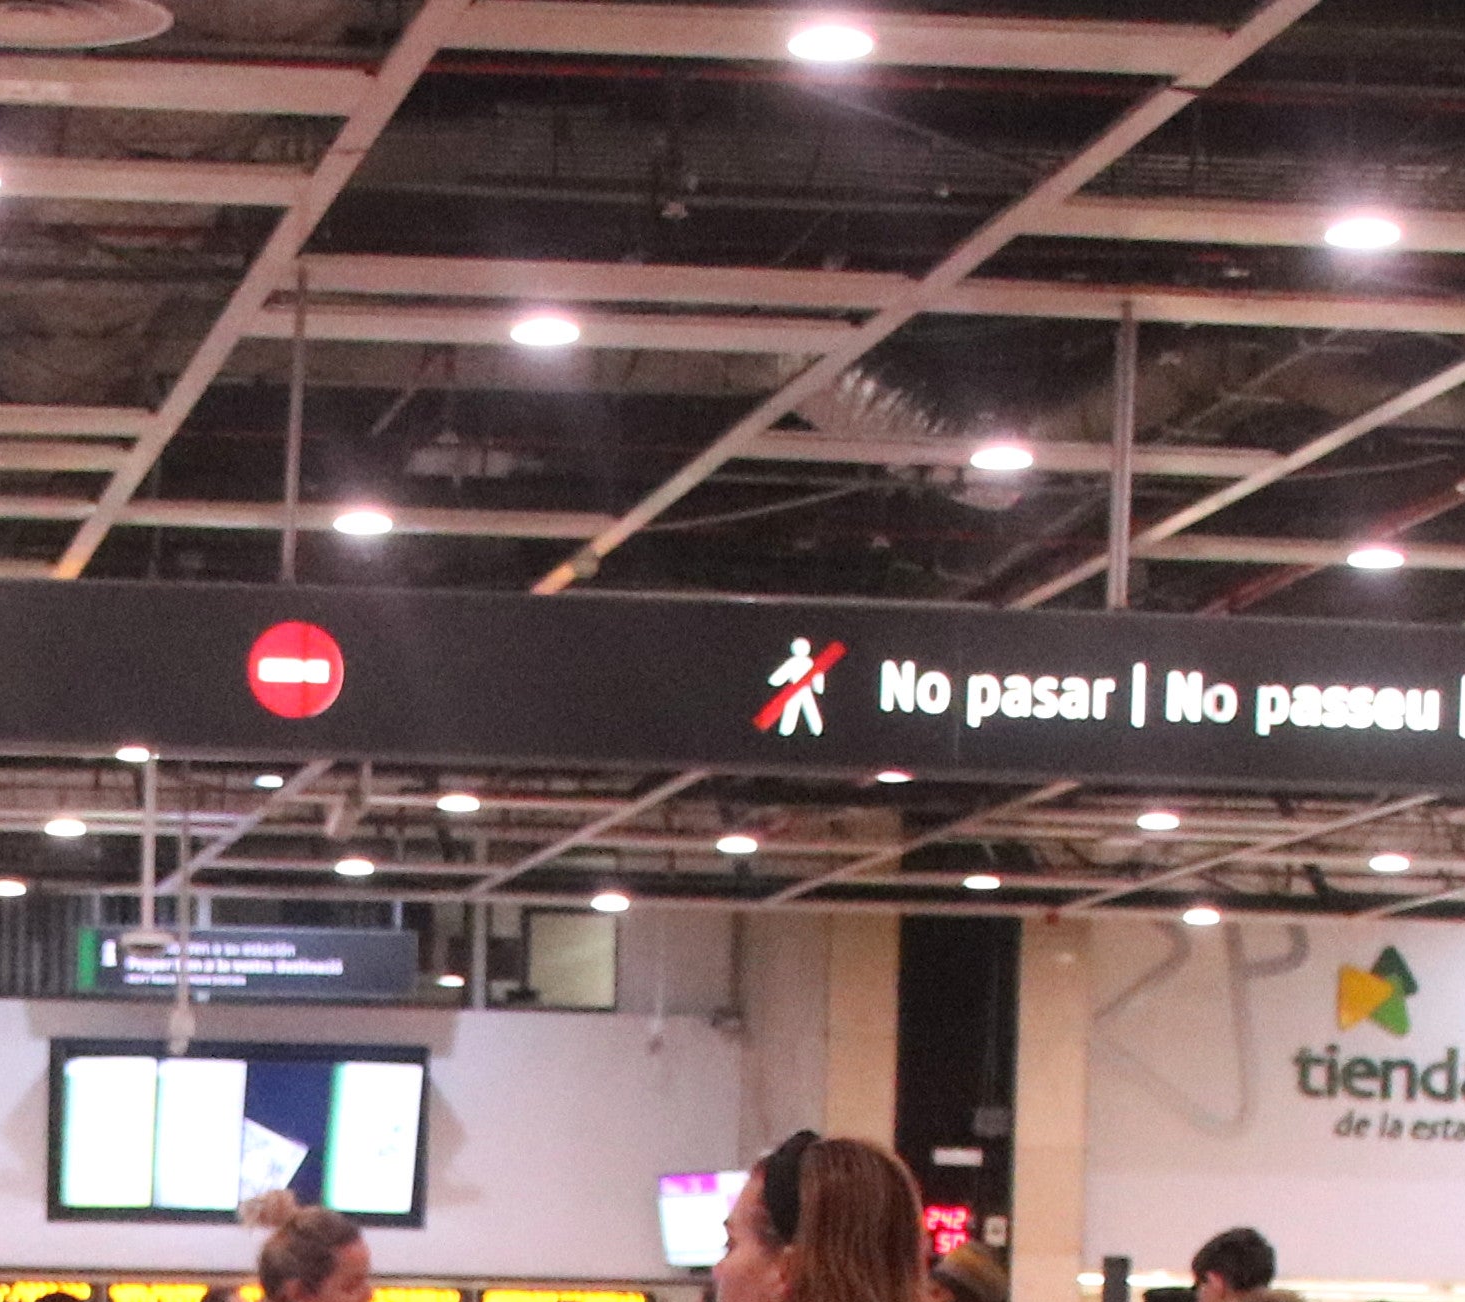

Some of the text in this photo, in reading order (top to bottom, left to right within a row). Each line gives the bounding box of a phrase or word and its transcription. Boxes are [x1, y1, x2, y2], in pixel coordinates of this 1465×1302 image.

[879, 659, 952, 715] No
[966, 673, 1117, 729] pasar
[1165, 669, 1239, 724] No
[1254, 683, 1441, 737] passeu
[1333, 1108, 1371, 1138] de
[1379, 1110, 1404, 1139] la
